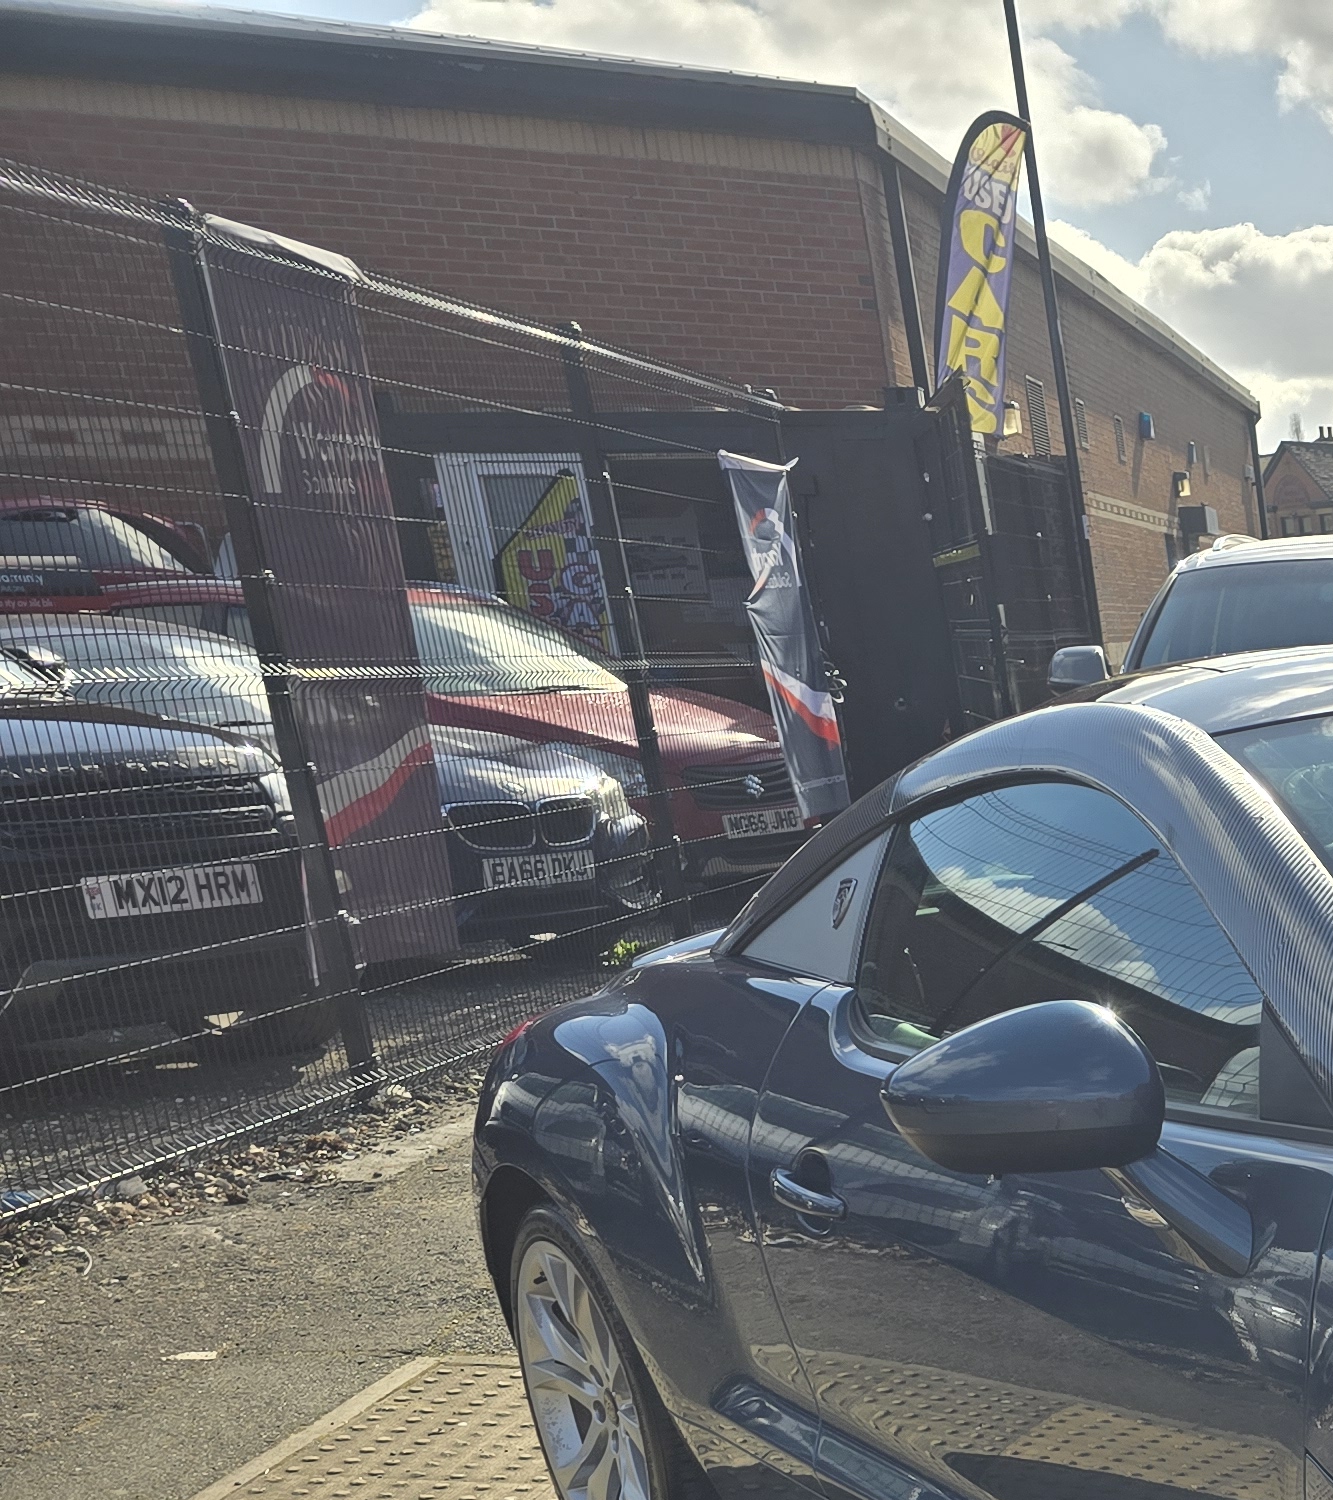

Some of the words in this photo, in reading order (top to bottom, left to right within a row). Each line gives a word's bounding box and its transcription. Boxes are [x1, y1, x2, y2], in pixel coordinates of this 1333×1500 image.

[948, 209, 1006, 433] CARS
[112, 874, 189, 910] MX12
[194, 870, 250, 903] HRM
